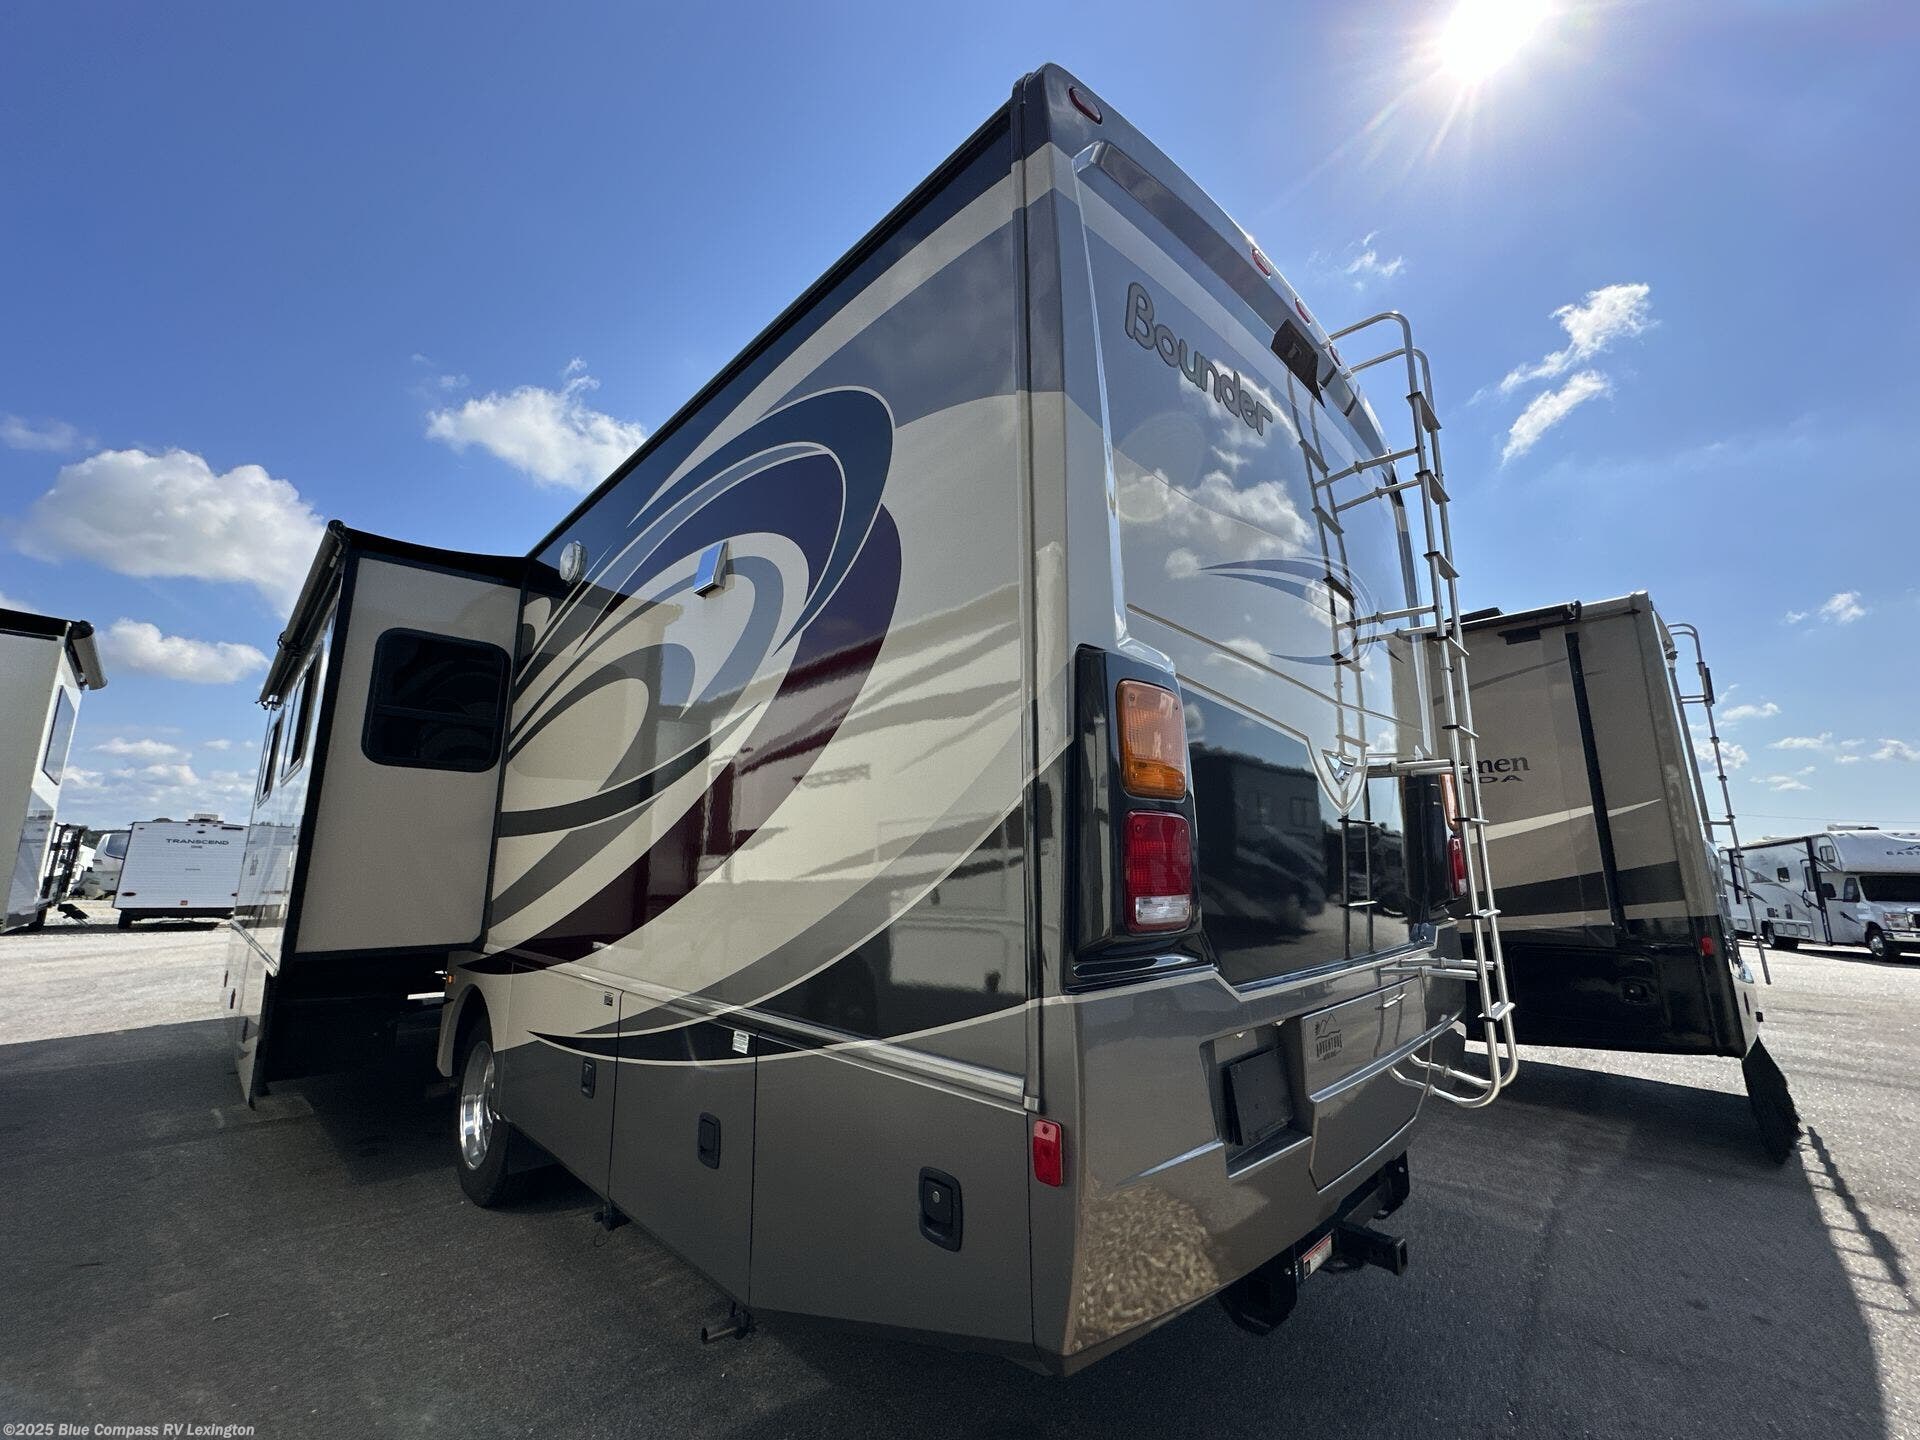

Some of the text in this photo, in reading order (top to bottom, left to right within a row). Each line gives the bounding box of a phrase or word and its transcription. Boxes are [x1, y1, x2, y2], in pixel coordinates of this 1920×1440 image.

[1125, 282, 1273, 437] Bounder
[1461, 756, 1531, 774] men
[166, 838, 229, 846] TRANSCEND
